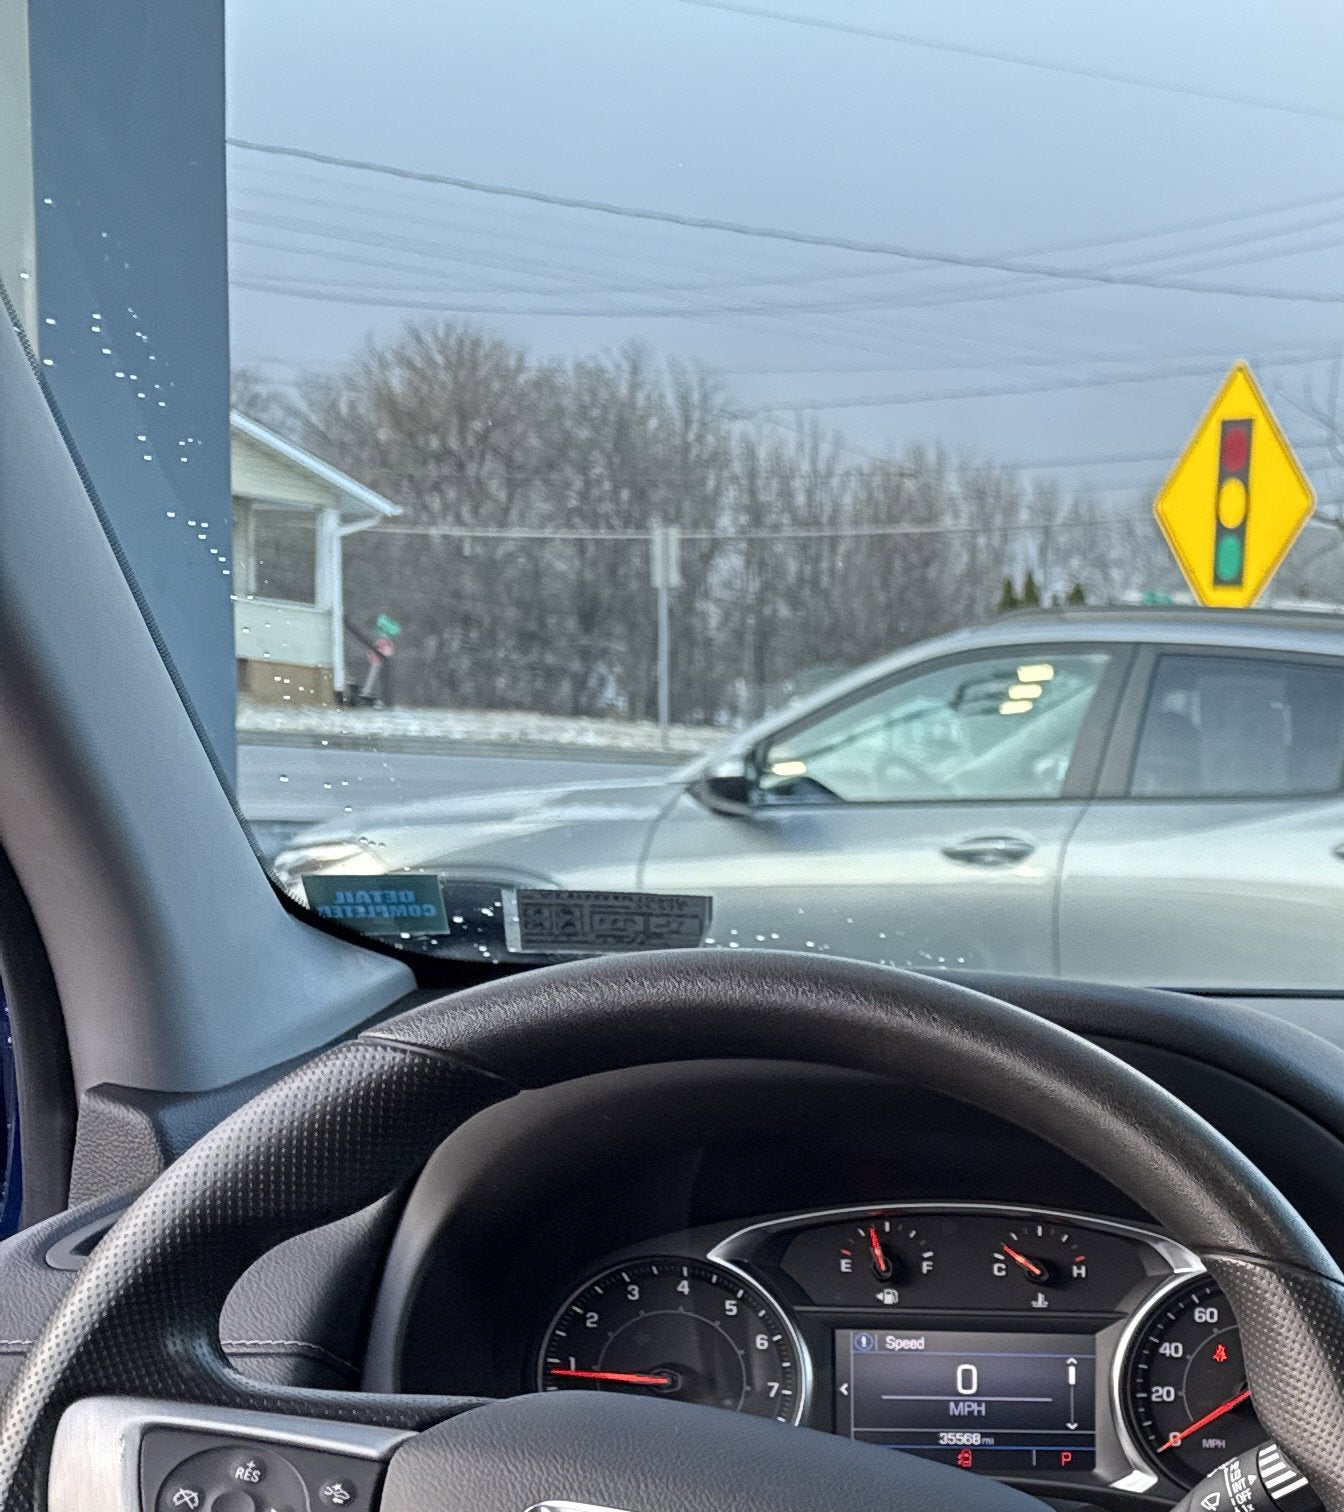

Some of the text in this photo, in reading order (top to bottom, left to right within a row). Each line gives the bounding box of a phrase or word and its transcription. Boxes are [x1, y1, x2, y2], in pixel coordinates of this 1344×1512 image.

[840, 1259, 852, 1272] E
[922, 1261, 934, 1274] F
[993, 1263, 1007, 1277] C
[1072, 1265, 1086, 1278] H
[626, 1285, 640, 1300] 3
[676, 1280, 690, 1295] 4
[725, 1300, 738, 1316] 5
[1194, 1307, 1218, 1323] 60
[586, 1312, 599, 1328] 2
[755, 1334, 769, 1350] 6
[885, 1335, 925, 1352] Speed
[1158, 1342, 1183, 1358] 40
[956, 1363, 978, 1395] 0
[767, 1381, 779, 1397] 7
[1151, 1386, 1175, 1402] 20
[949, 1401, 986, 1416] MPH
[939, 1432, 981, 1446] 35568
[1202, 1438, 1226, 1449] MPH
[1061, 1451, 1072, 1467] P
[234, 1466, 261, 1483] RES
[1232, 1477, 1246, 1494] INT
